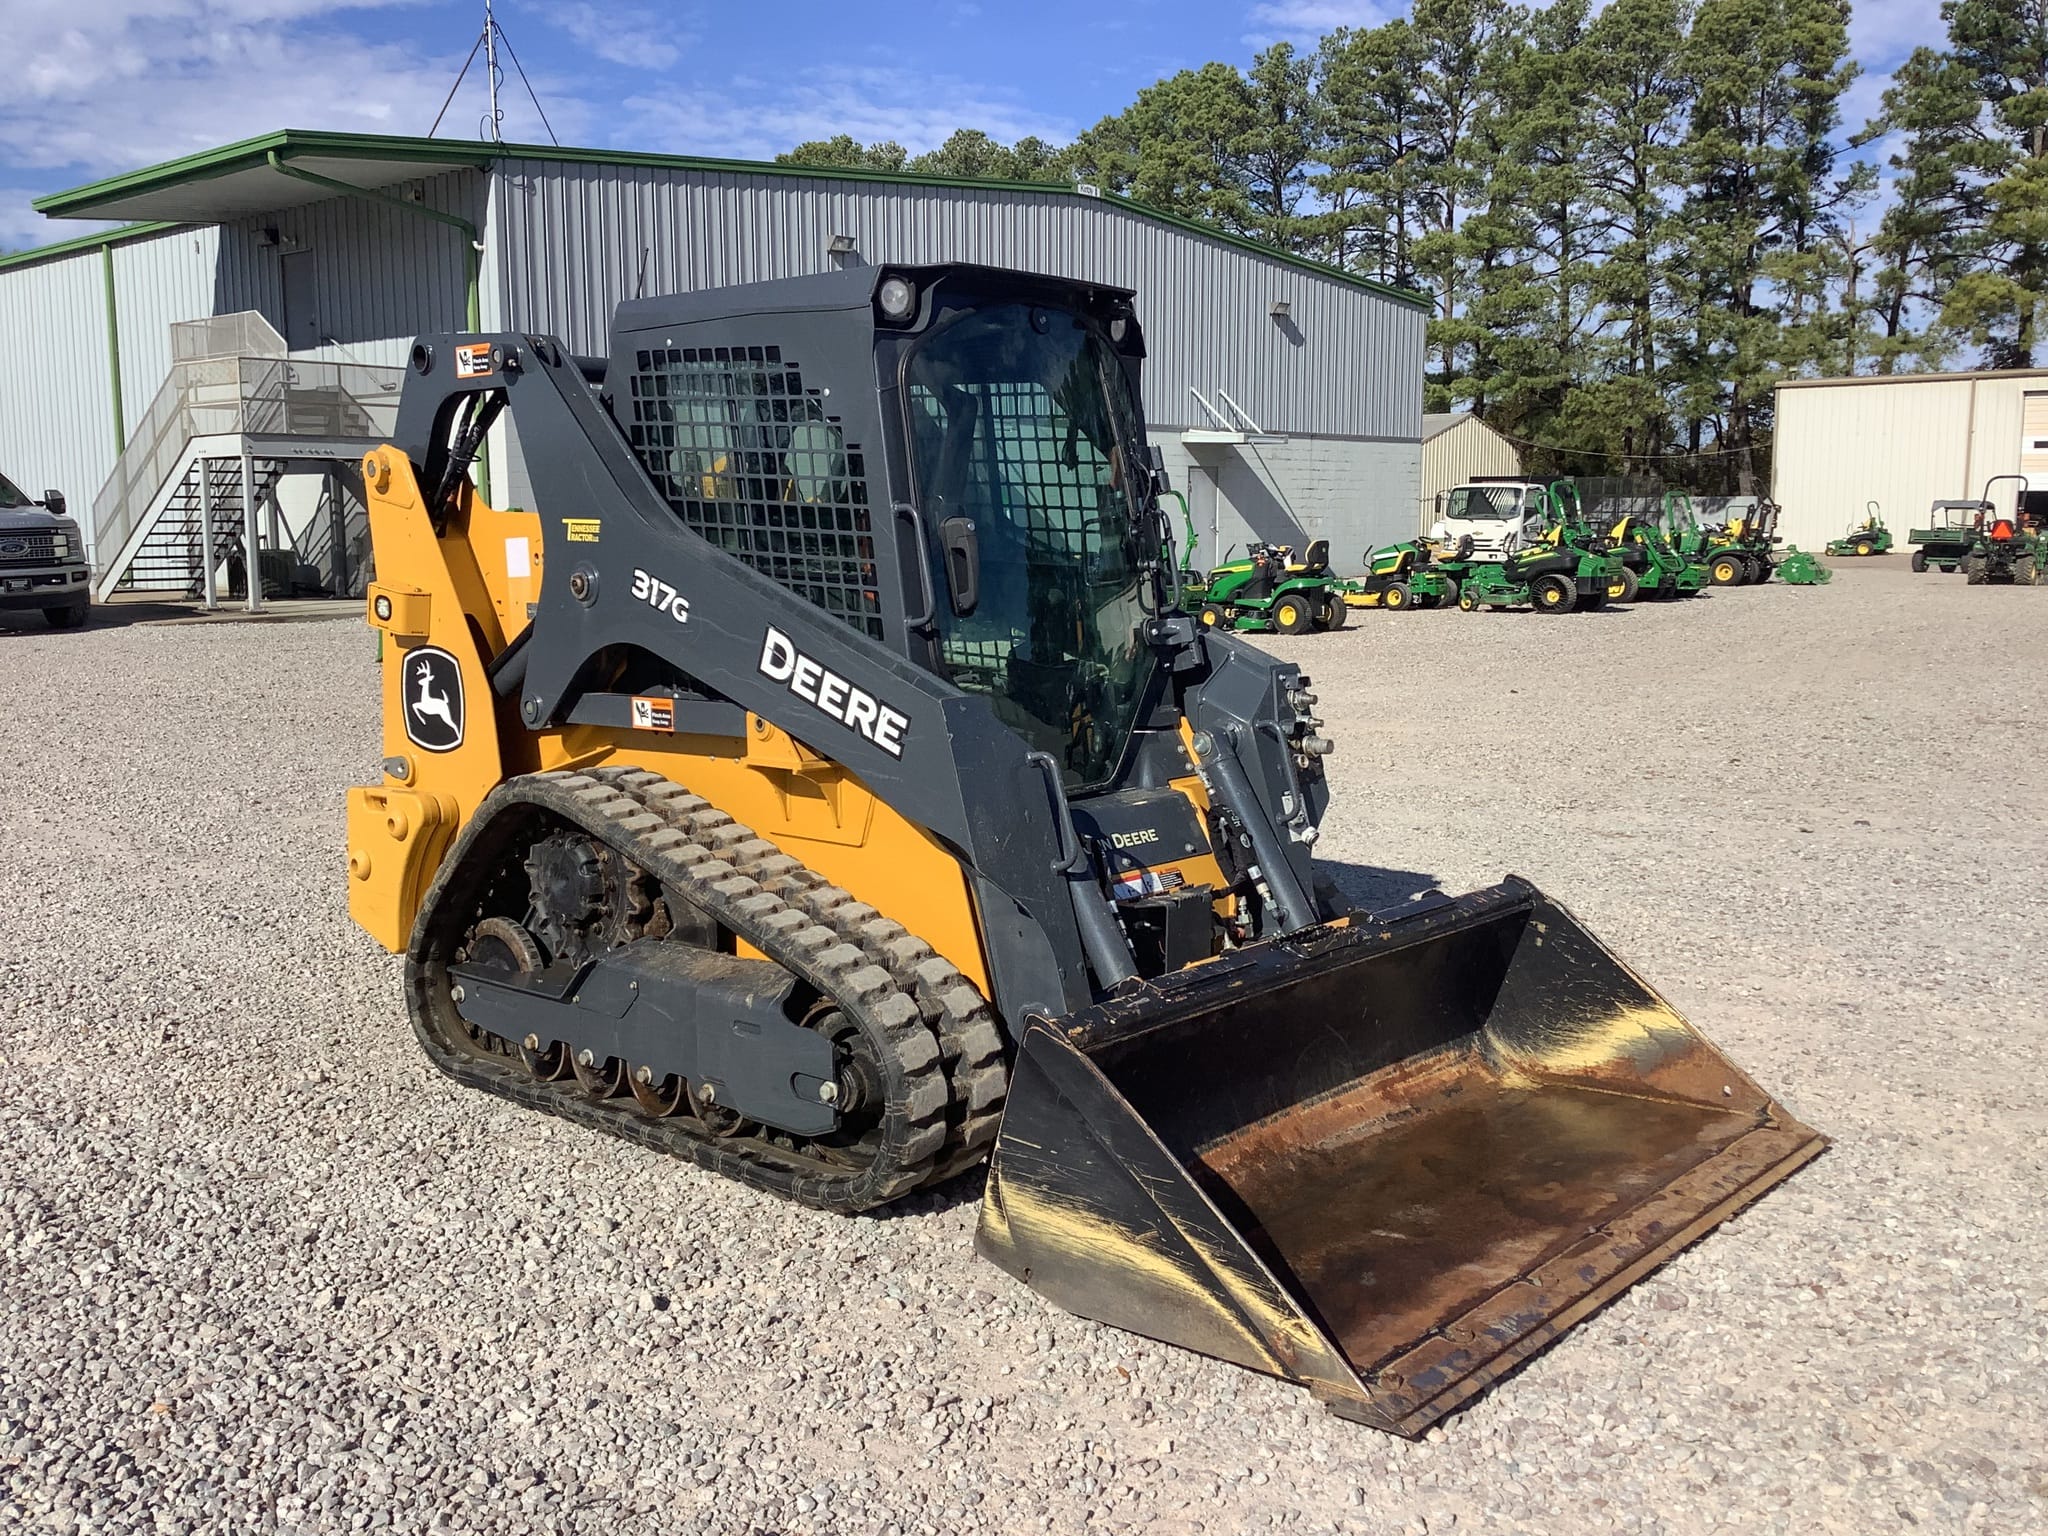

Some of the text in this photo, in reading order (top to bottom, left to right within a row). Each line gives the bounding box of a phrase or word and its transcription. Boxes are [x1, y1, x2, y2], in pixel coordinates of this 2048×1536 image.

[631, 568, 690, 623] 317G
[759, 626, 908, 757] DEERE
[1111, 828, 1159, 849] DEERE
